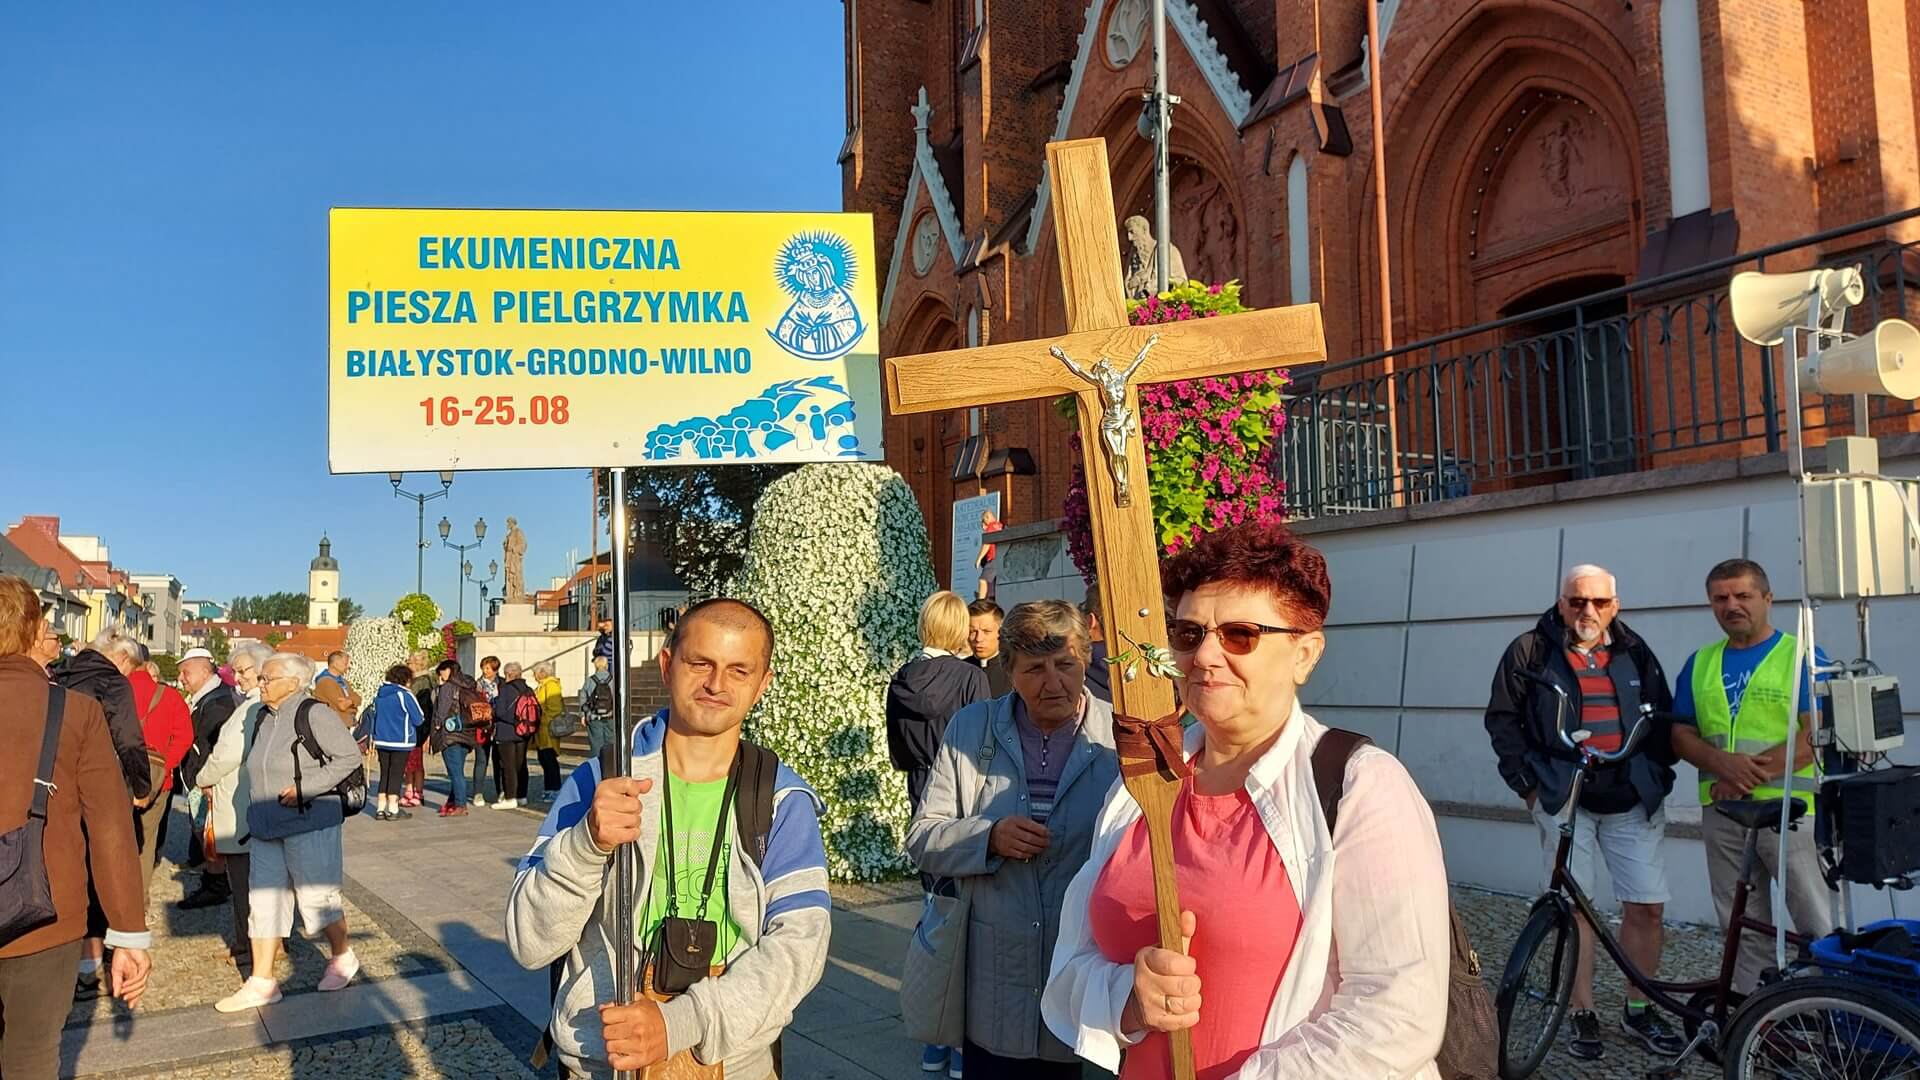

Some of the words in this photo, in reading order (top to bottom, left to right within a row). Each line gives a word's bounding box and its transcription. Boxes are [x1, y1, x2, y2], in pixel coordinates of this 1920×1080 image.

[419, 236, 680, 270] EKUMENICZNA
[347, 290, 477, 324] PIESZA
[493, 290, 749, 324] PIELGRZYMKA
[346, 347, 751, 377] BIAŁYSTOK-GRODNO-WILNO
[419, 395, 570, 427] 16-25.08
